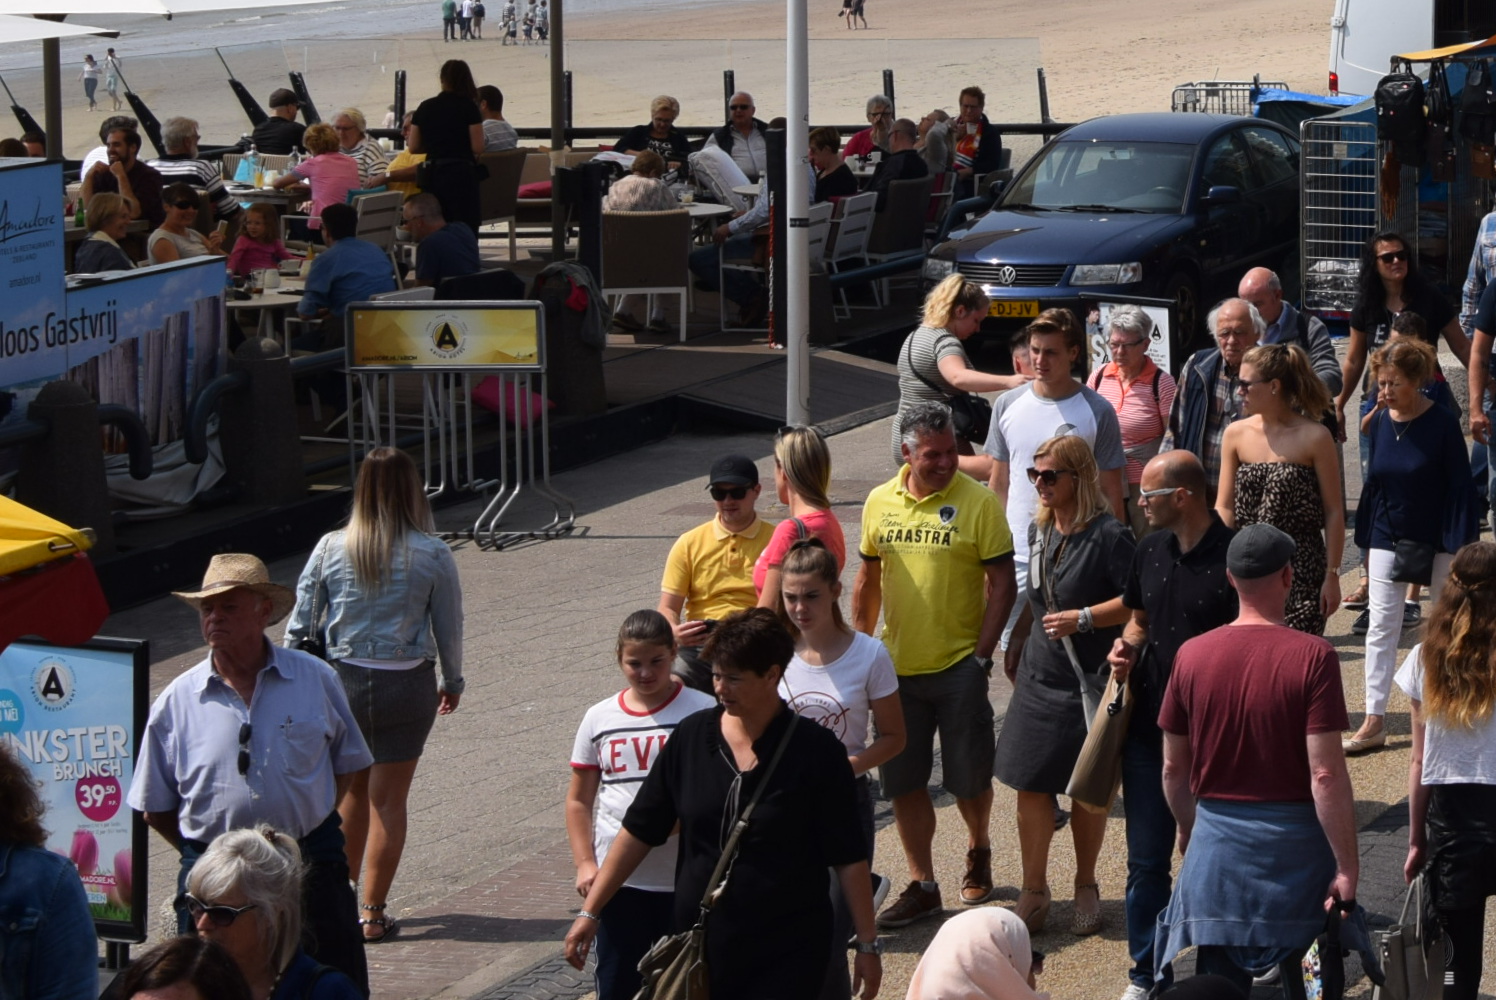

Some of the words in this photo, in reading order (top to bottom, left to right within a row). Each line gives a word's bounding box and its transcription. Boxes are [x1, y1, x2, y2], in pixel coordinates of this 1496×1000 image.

[45, 300, 118, 347] Gastvrij
[437, 322, 459, 349] A
[886, 528, 951, 547] GAASTRA
[41, 666, 65, 700] A
[54, 760, 123, 782] BRUNCH
[79, 875, 116, 885] MADORE.NL
